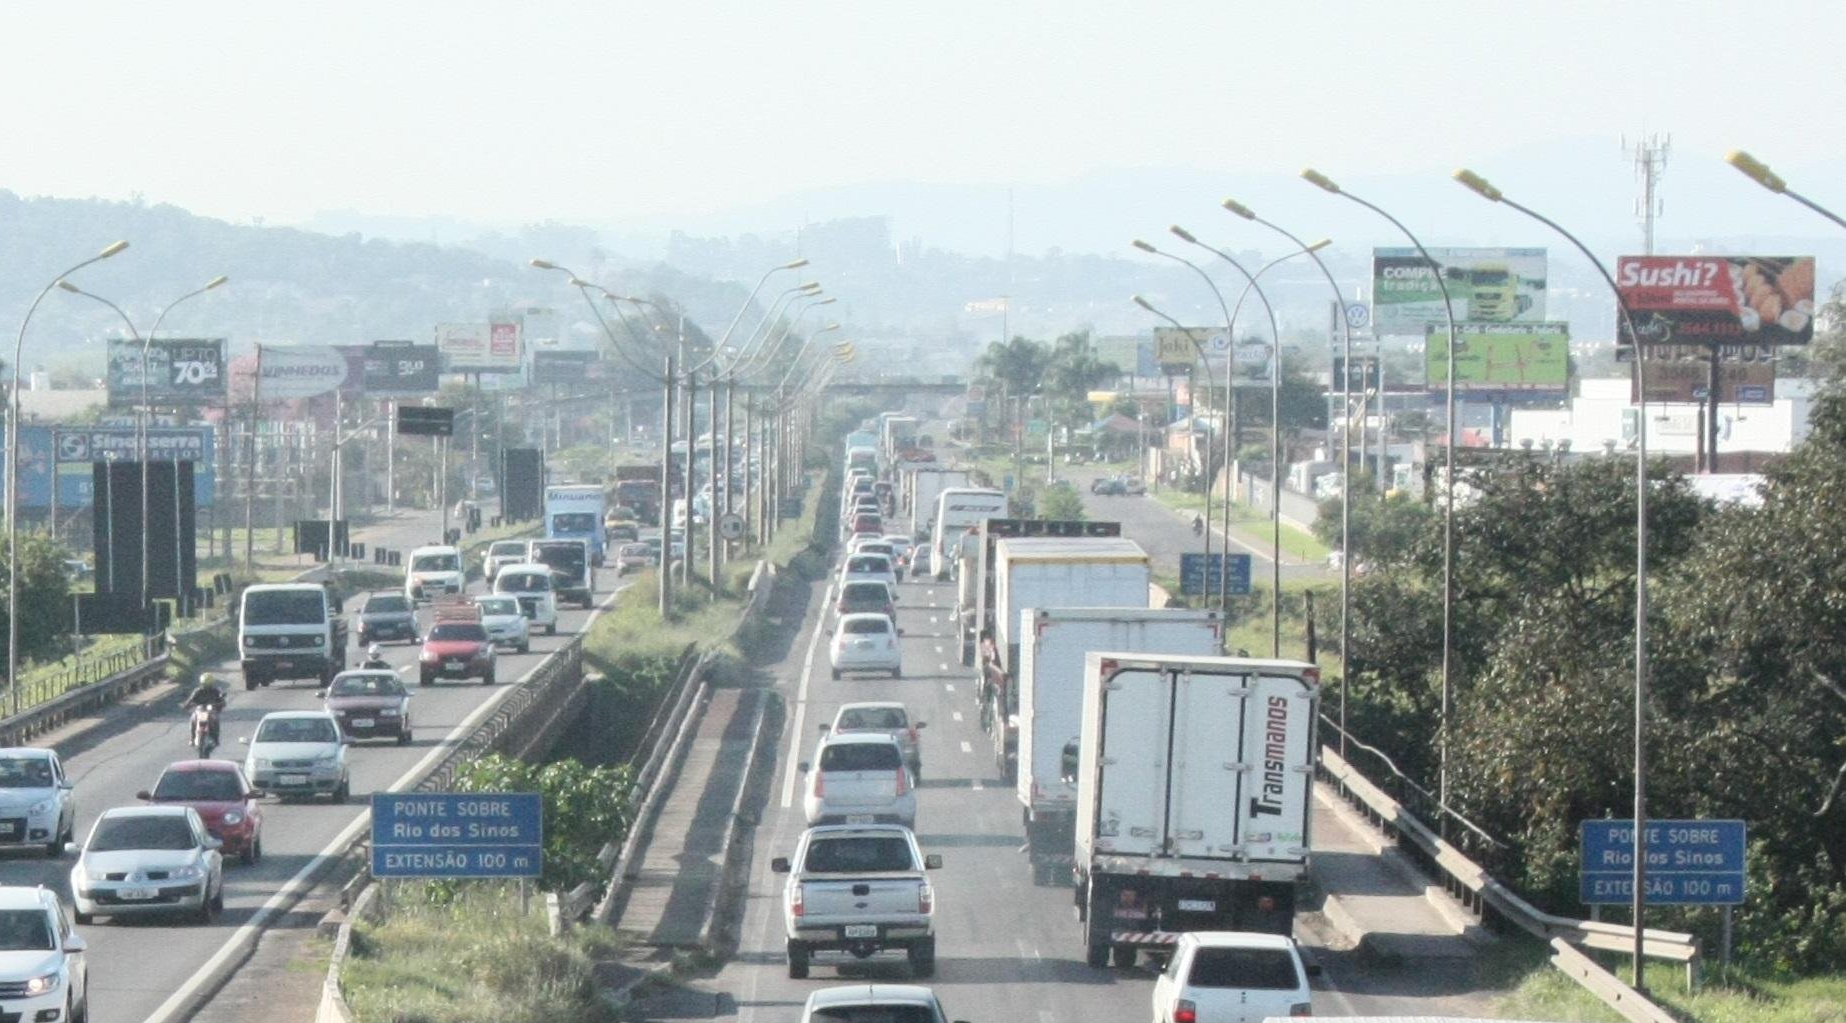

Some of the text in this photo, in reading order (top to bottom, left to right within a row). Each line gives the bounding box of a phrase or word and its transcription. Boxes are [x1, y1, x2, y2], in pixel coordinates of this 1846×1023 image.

[1621, 262, 1719, 288] Sushi?
[1250, 695, 1288, 819] Transmanos
[394, 801, 511, 817] PONTE SOBRE
[394, 823, 519, 838] Rio dos Sinos
[1669, 828, 1719, 844] SOBRE
[386, 850, 529, 869] EXTENSÃO 100 m
[1603, 849, 1631, 865] Rio
[1675, 849, 1724, 865] Sinos
[1594, 877, 1731, 896] EXTESÃO 100 m
